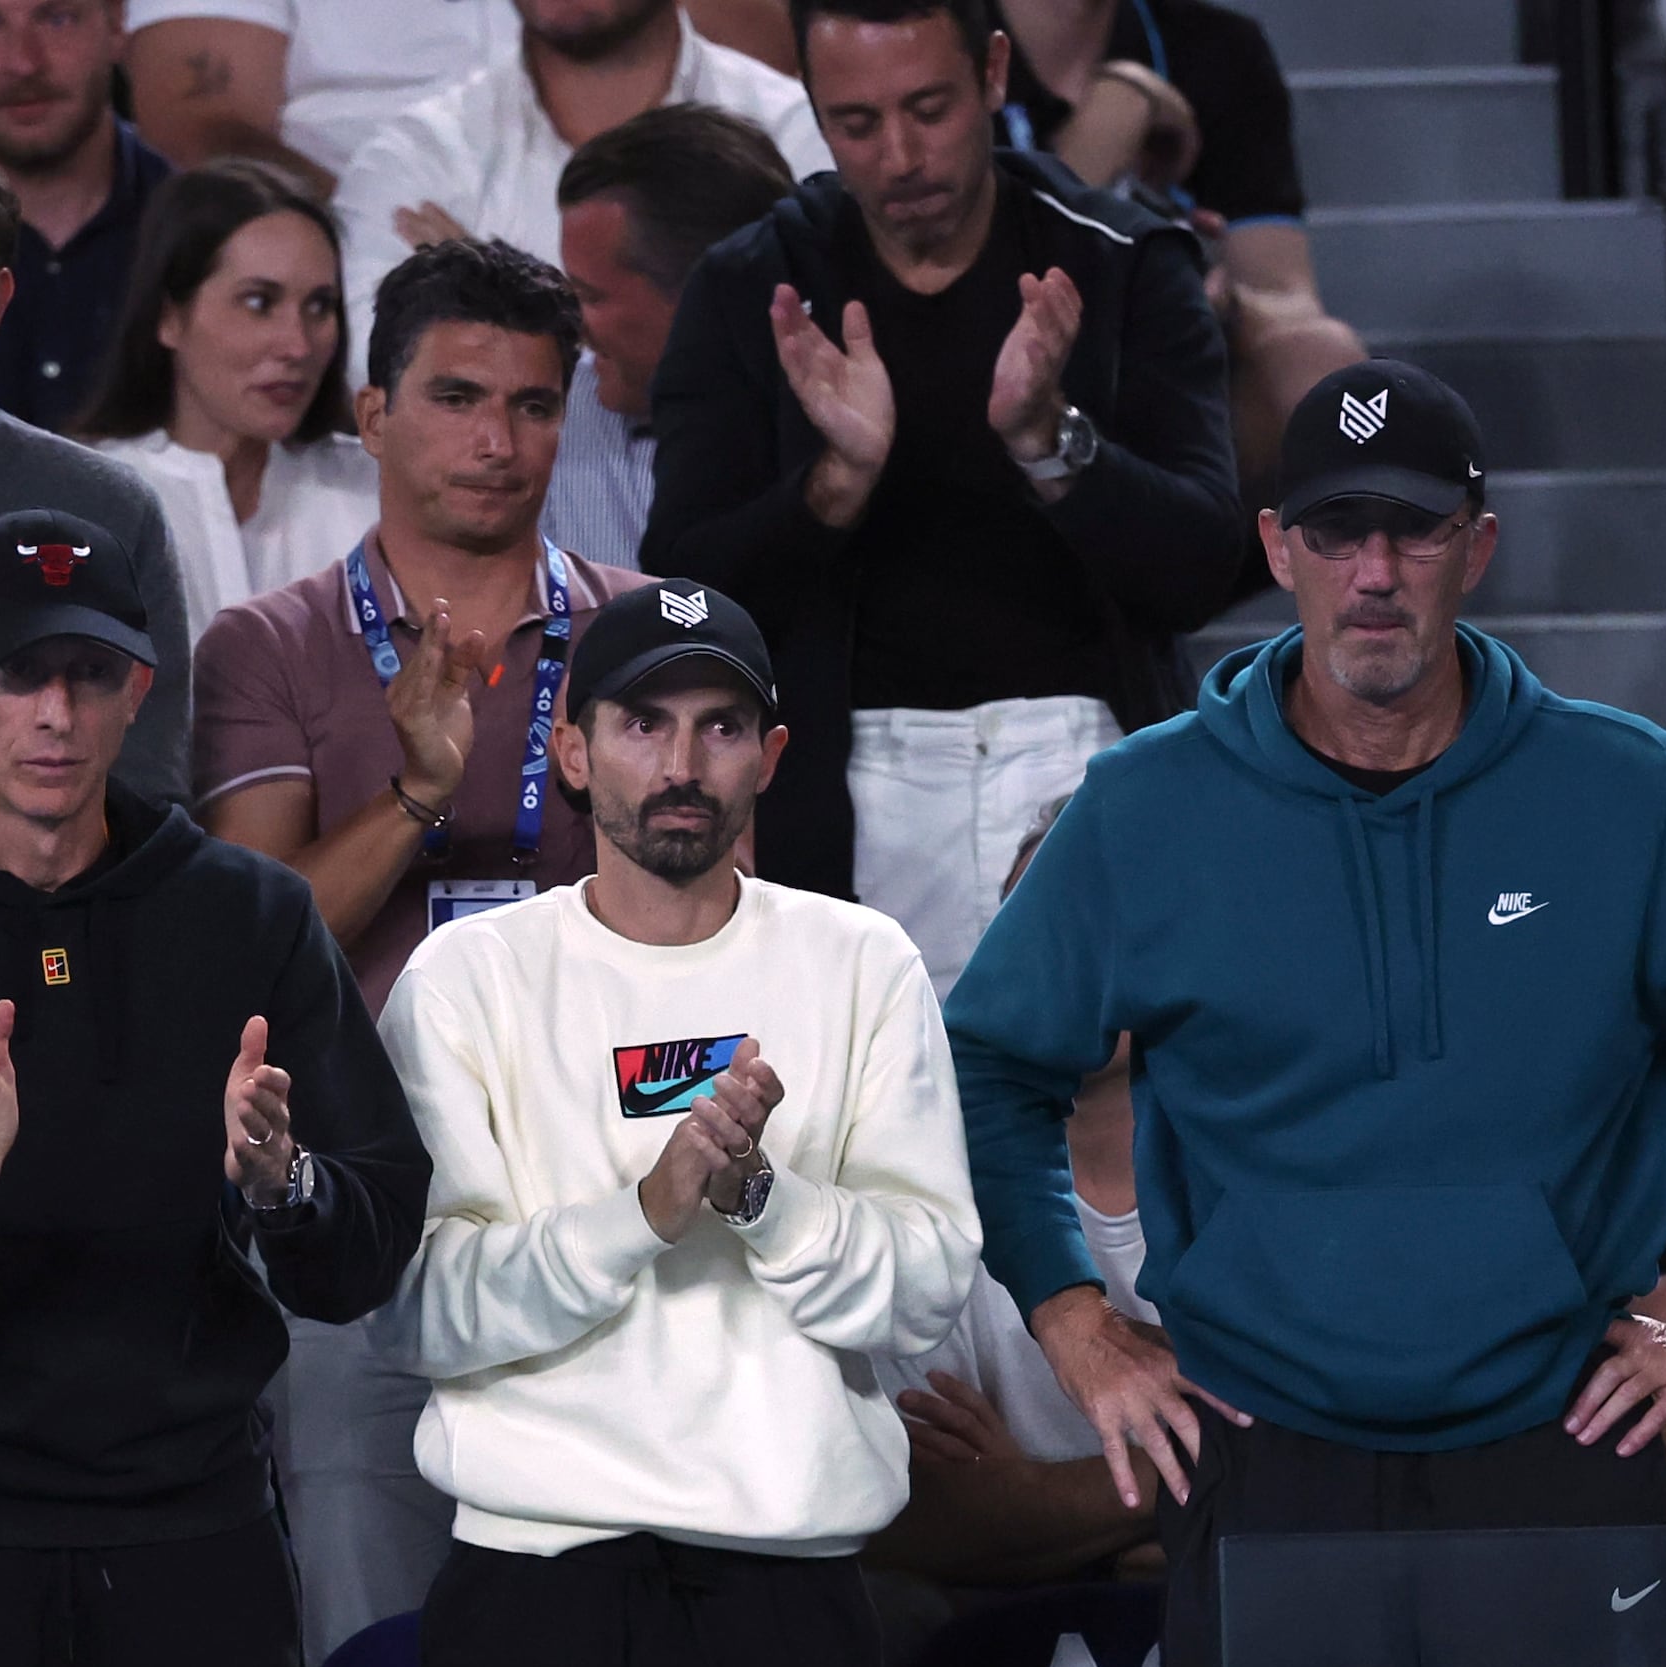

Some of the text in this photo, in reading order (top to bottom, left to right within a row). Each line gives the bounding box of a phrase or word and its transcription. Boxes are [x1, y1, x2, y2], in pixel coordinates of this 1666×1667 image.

[536, 687, 552, 712] AO
[522, 781, 539, 810] AO
[1496, 892, 1532, 912] NIKE
[641, 1038, 714, 1082] NIKE
